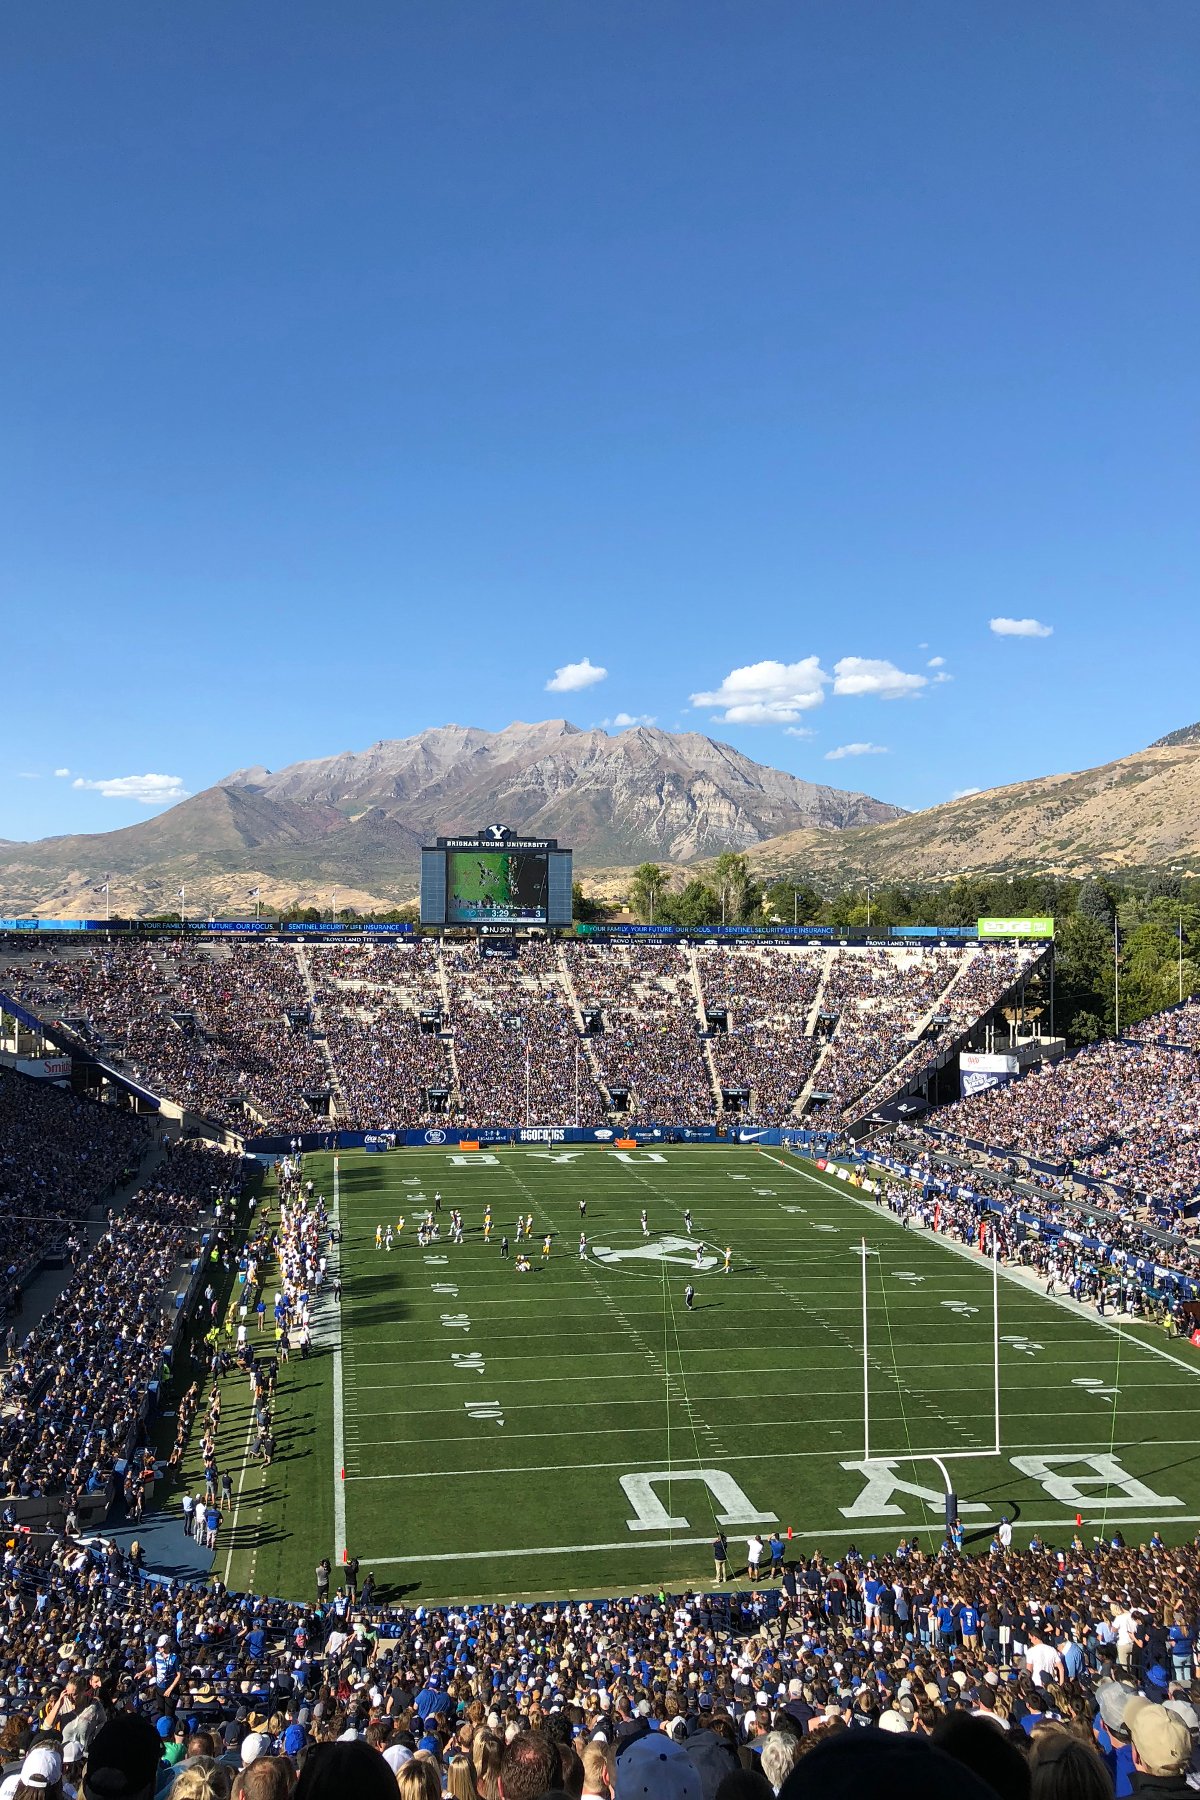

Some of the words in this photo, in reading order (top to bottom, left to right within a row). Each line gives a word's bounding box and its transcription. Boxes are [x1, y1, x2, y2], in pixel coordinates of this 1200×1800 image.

[488, 825, 507, 839] Y
[491, 909, 509, 917] 3:29
[940, 1300, 980, 1312] 30
[439, 1313, 472, 1327] 30
[999, 1335, 1046, 1350] 20
[450, 1352, 486, 1368] 20
[1070, 1378, 1122, 1394] 10
[464, 1400, 504, 1418] 10
